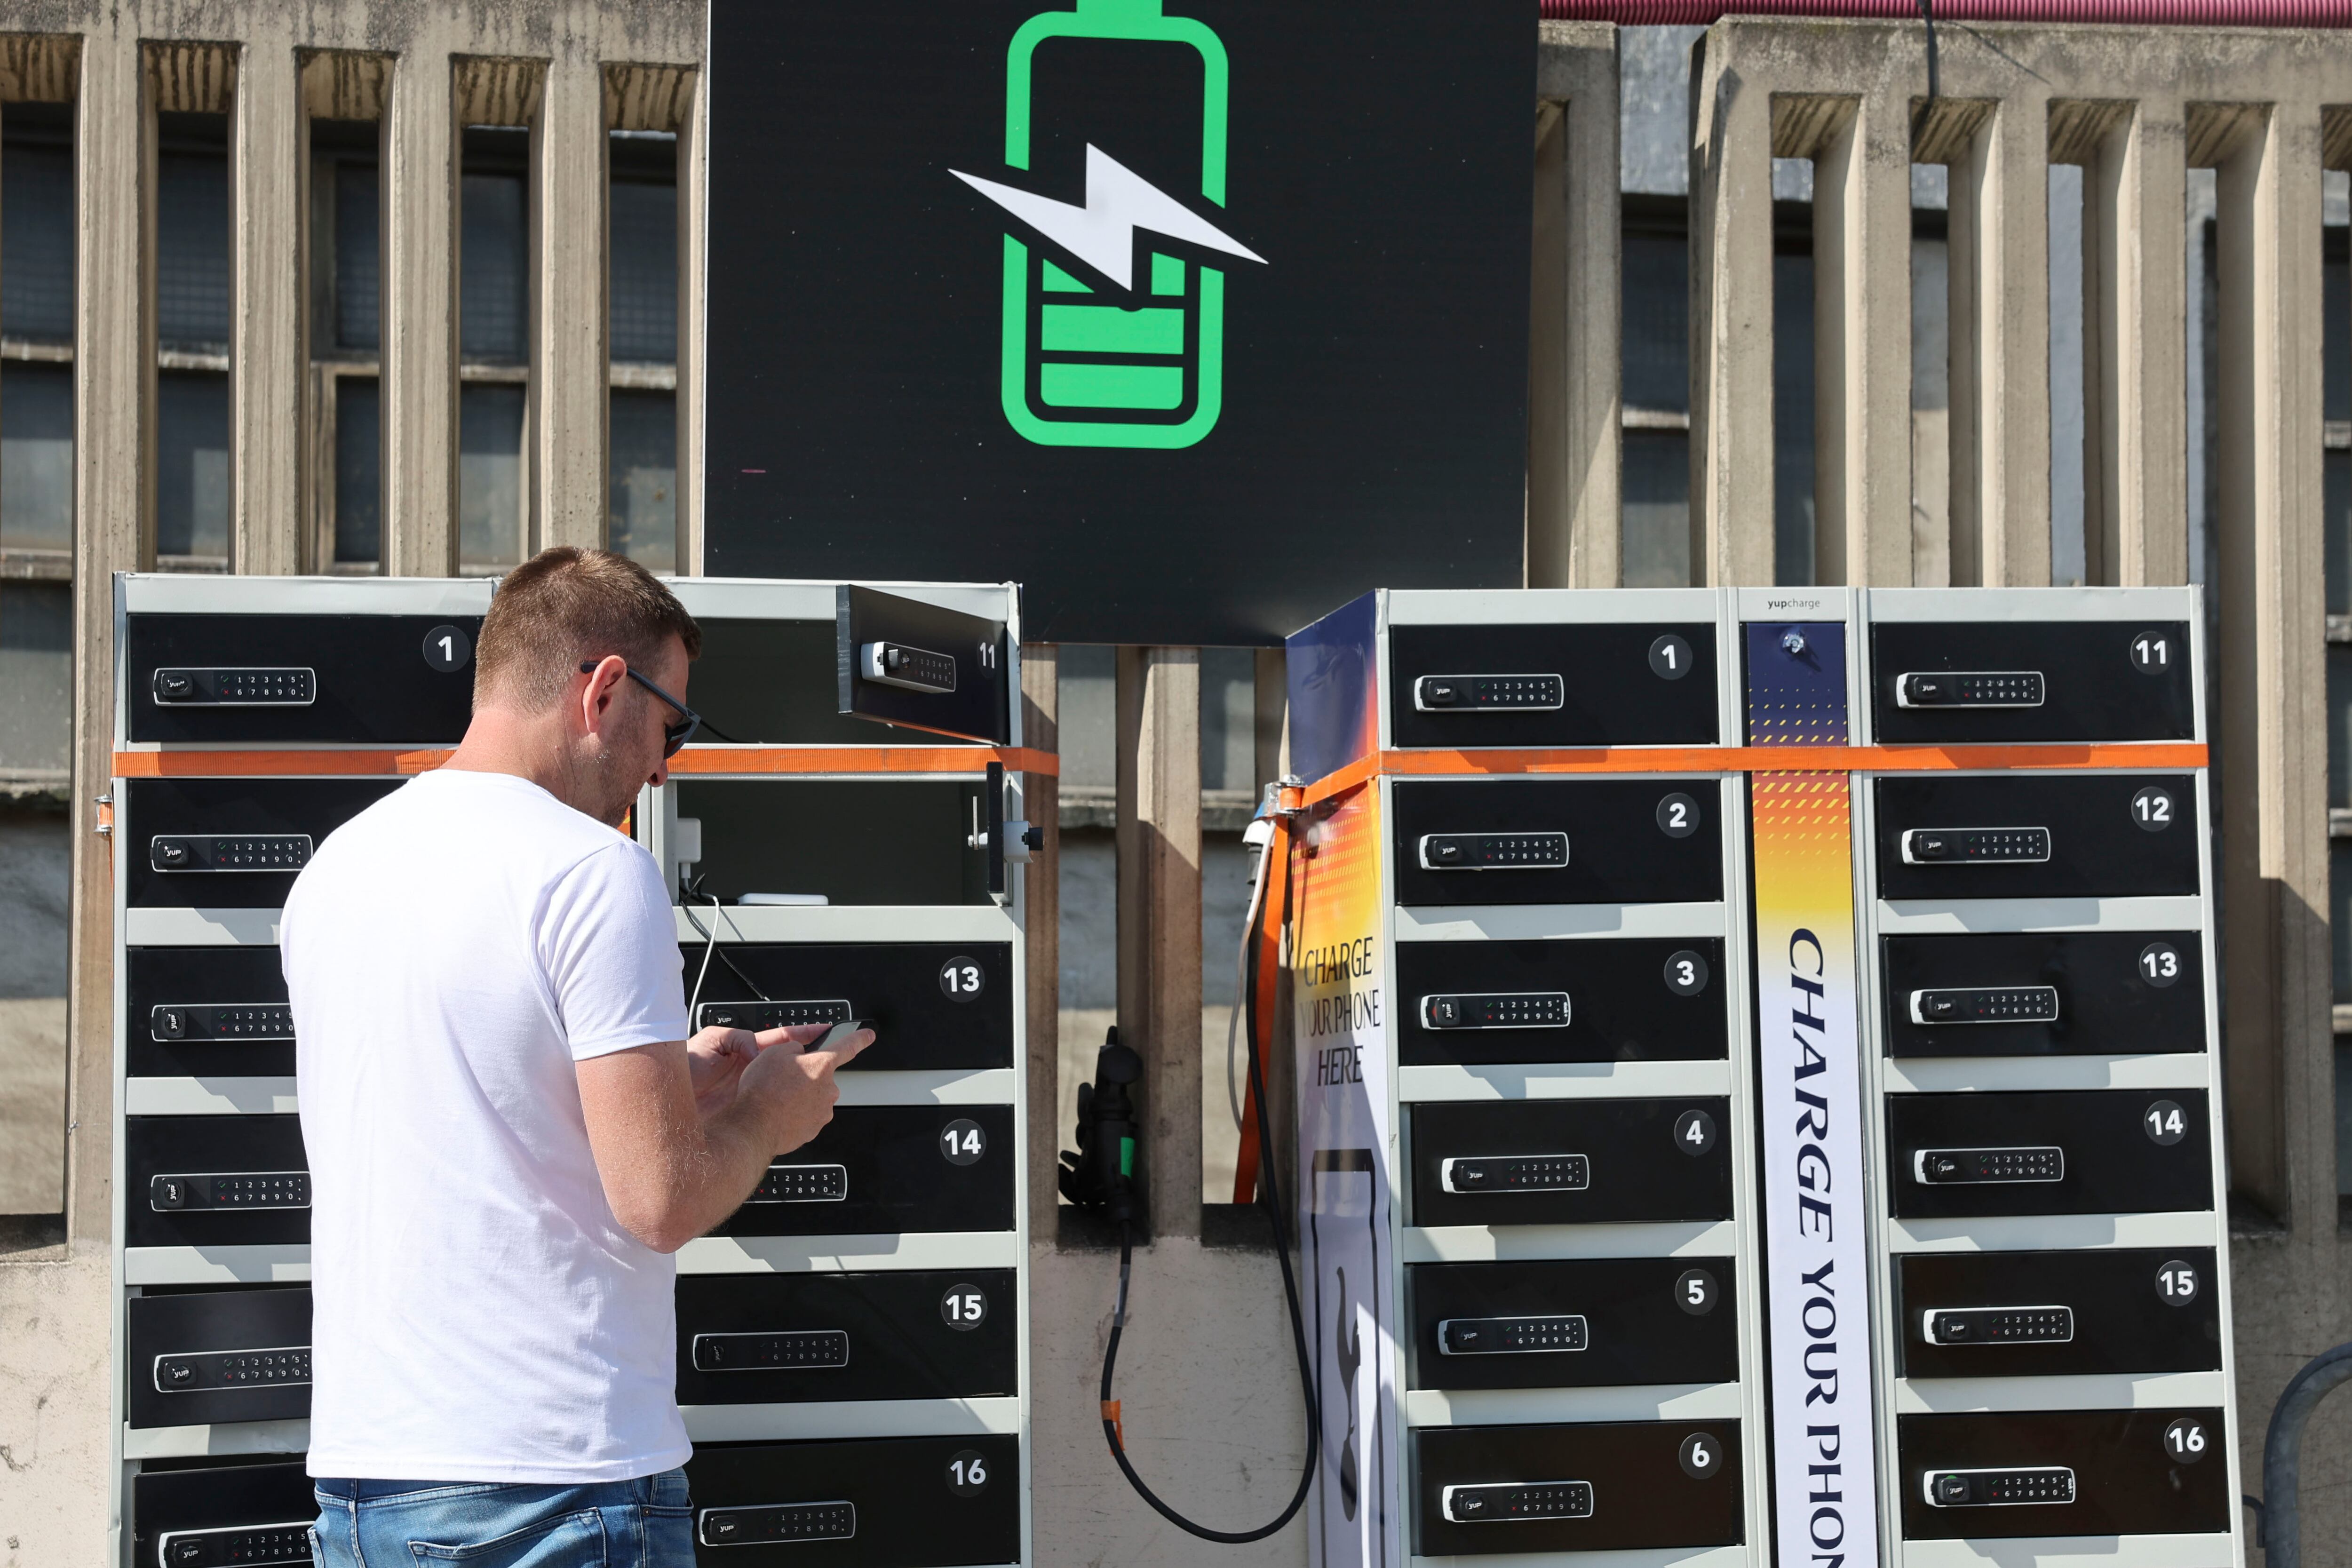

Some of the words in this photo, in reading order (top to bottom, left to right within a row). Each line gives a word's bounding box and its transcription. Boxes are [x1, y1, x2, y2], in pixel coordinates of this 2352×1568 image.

[1767, 598, 1820, 610] yupcharge
[438, 636, 452, 661] 1
[979, 642, 995, 669] 11
[1661, 645, 1676, 669] 1
[2136, 640, 2166, 664] 11
[1669, 803, 1687, 828] 2
[2135, 796, 2169, 821] 12
[1304, 936, 1373, 987] CHARGE
[1677, 960, 1695, 986] 3
[2143, 952, 2177, 978] 13
[944, 966, 979, 992] 13
[1335, 989, 1380, 1033] PHONE
[1317, 1045, 1363, 1087] HERE
[1789, 928, 1833, 1242] CHARGE
[1686, 1120, 1704, 1145] 4
[2148, 1109, 2184, 1136] 14
[944, 1129, 981, 1155] 14
[1687, 1279, 1705, 1305] 5
[2160, 1271, 2194, 1296] 15
[946, 1295, 982, 1320] 15
[1801, 1258, 1838, 1408] YOUR
[2169, 1426, 2205, 1452] 16
[1692, 1441, 1710, 1467] 6
[950, 1459, 986, 1485] 16
